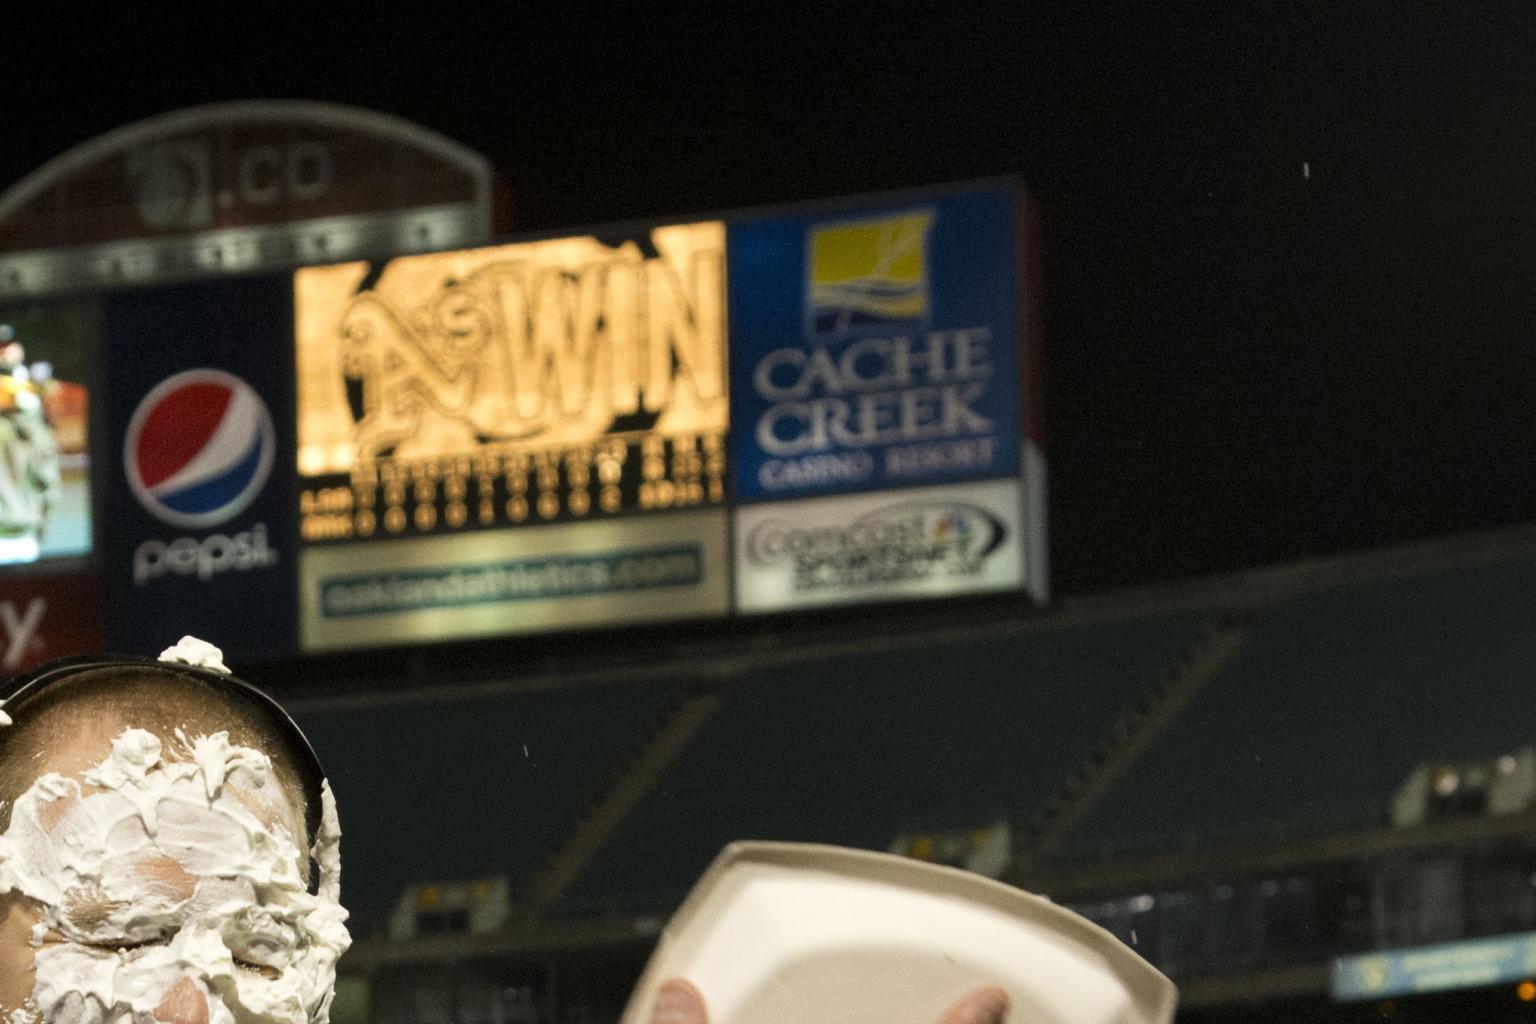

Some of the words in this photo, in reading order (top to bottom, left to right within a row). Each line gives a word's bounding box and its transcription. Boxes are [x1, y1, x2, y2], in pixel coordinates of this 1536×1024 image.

[753, 327, 995, 402] CACHE
[755, 384, 996, 455] CREEK
[133, 522, 271, 588] pepsi
